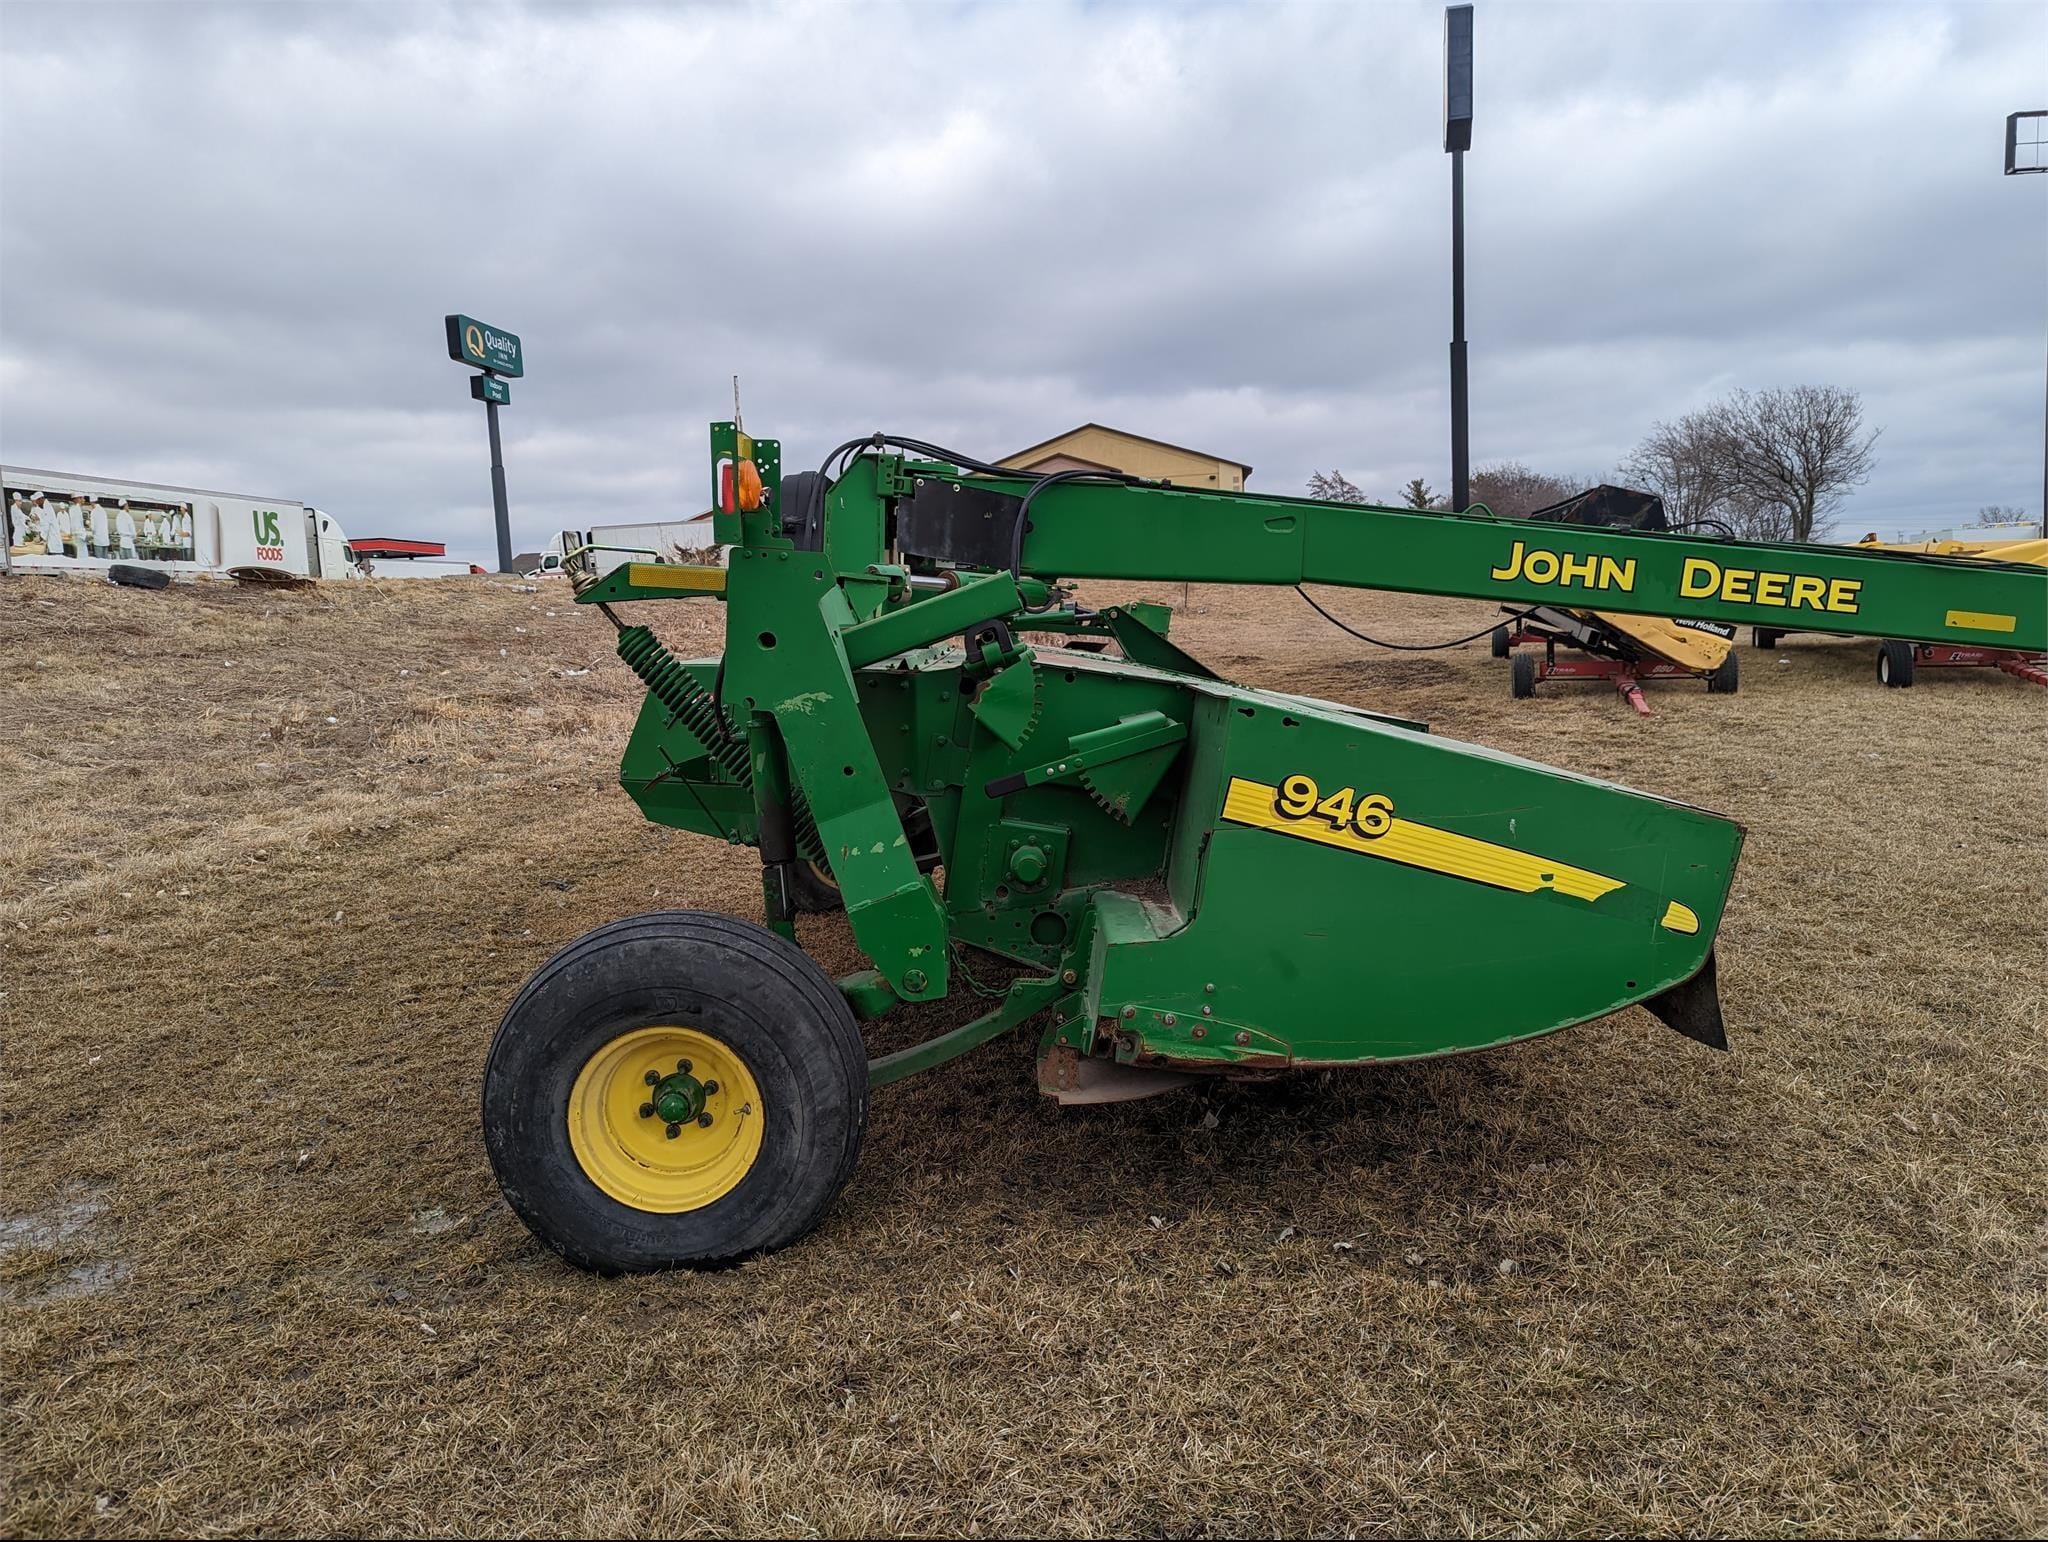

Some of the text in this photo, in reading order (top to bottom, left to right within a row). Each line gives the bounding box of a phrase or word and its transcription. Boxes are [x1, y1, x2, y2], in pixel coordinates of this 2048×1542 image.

[485, 330, 516, 358] Quality
[253, 510, 284, 546] US.
[257, 547, 283, 561] FOODS
[1491, 541, 1862, 614] JOHN DEERE
[1695, 621, 1730, 636] Holland
[1276, 774, 1394, 838] 946
